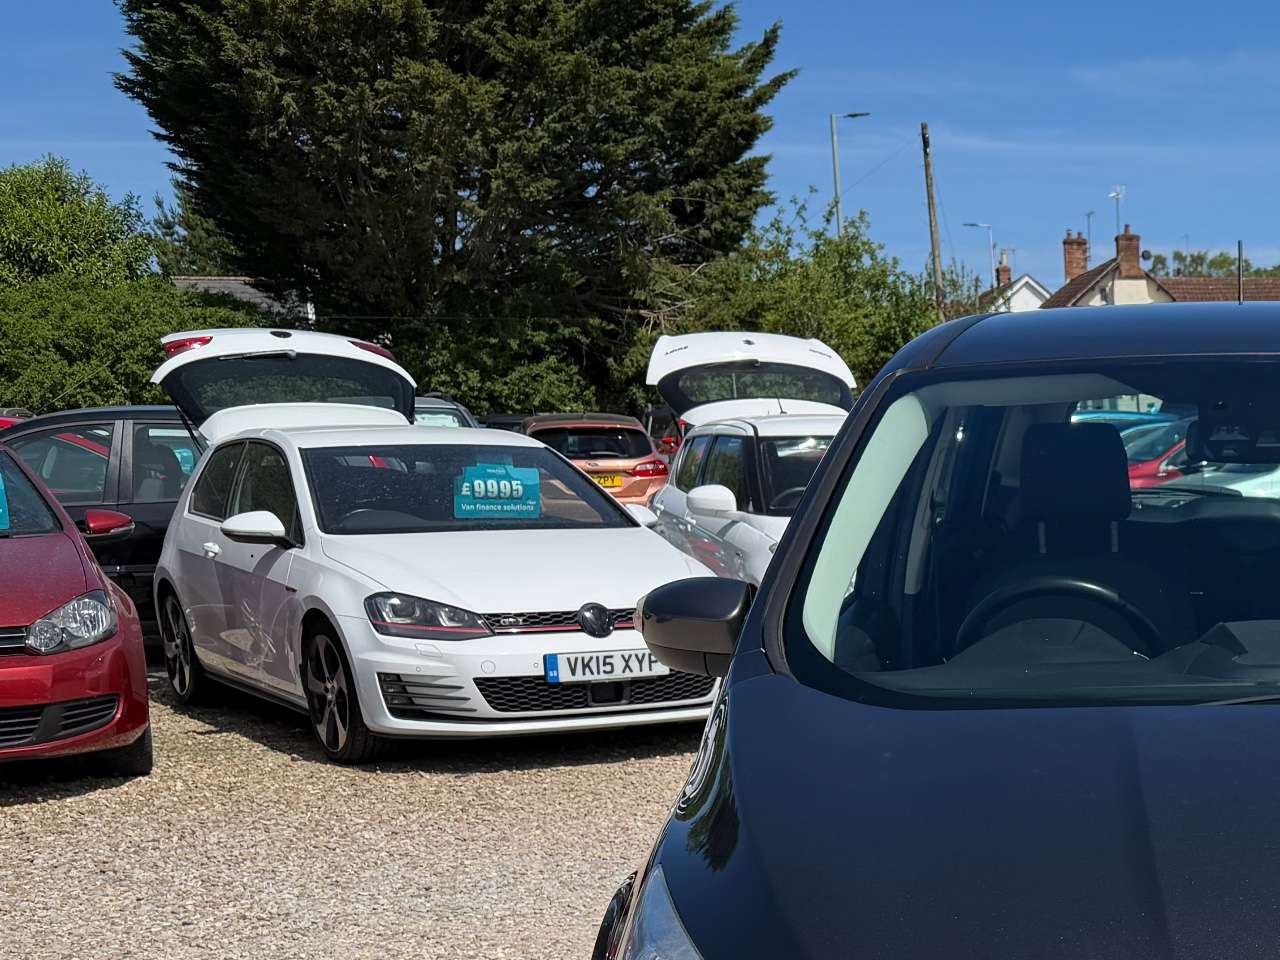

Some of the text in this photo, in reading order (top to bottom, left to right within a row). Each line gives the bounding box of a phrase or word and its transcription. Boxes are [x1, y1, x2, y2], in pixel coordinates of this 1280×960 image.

[461, 503, 534, 512] Van finance solutions
[566, 655, 615, 677] VK15
